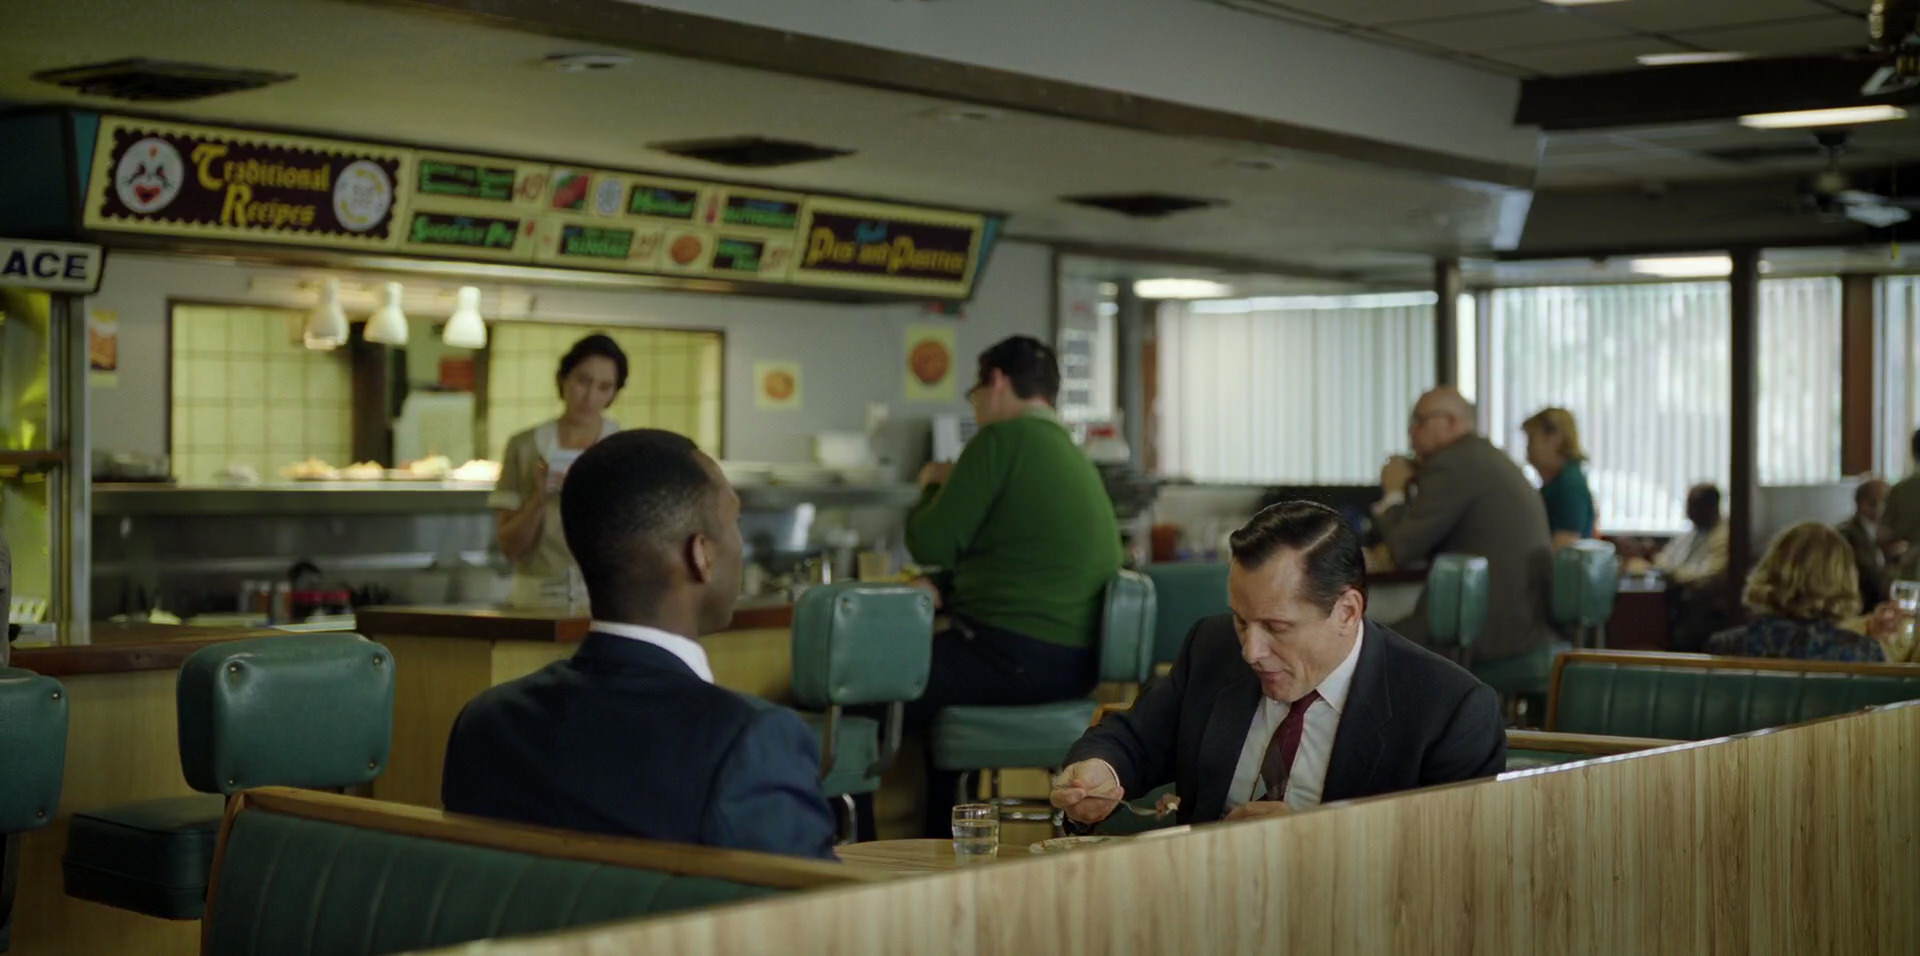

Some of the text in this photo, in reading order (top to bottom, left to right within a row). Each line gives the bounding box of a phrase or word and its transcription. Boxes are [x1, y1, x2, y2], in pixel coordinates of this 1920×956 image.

[191, 143, 330, 191] Traditional
[222, 184, 317, 227] Recipes
[2, 249, 89, 280] ACE
